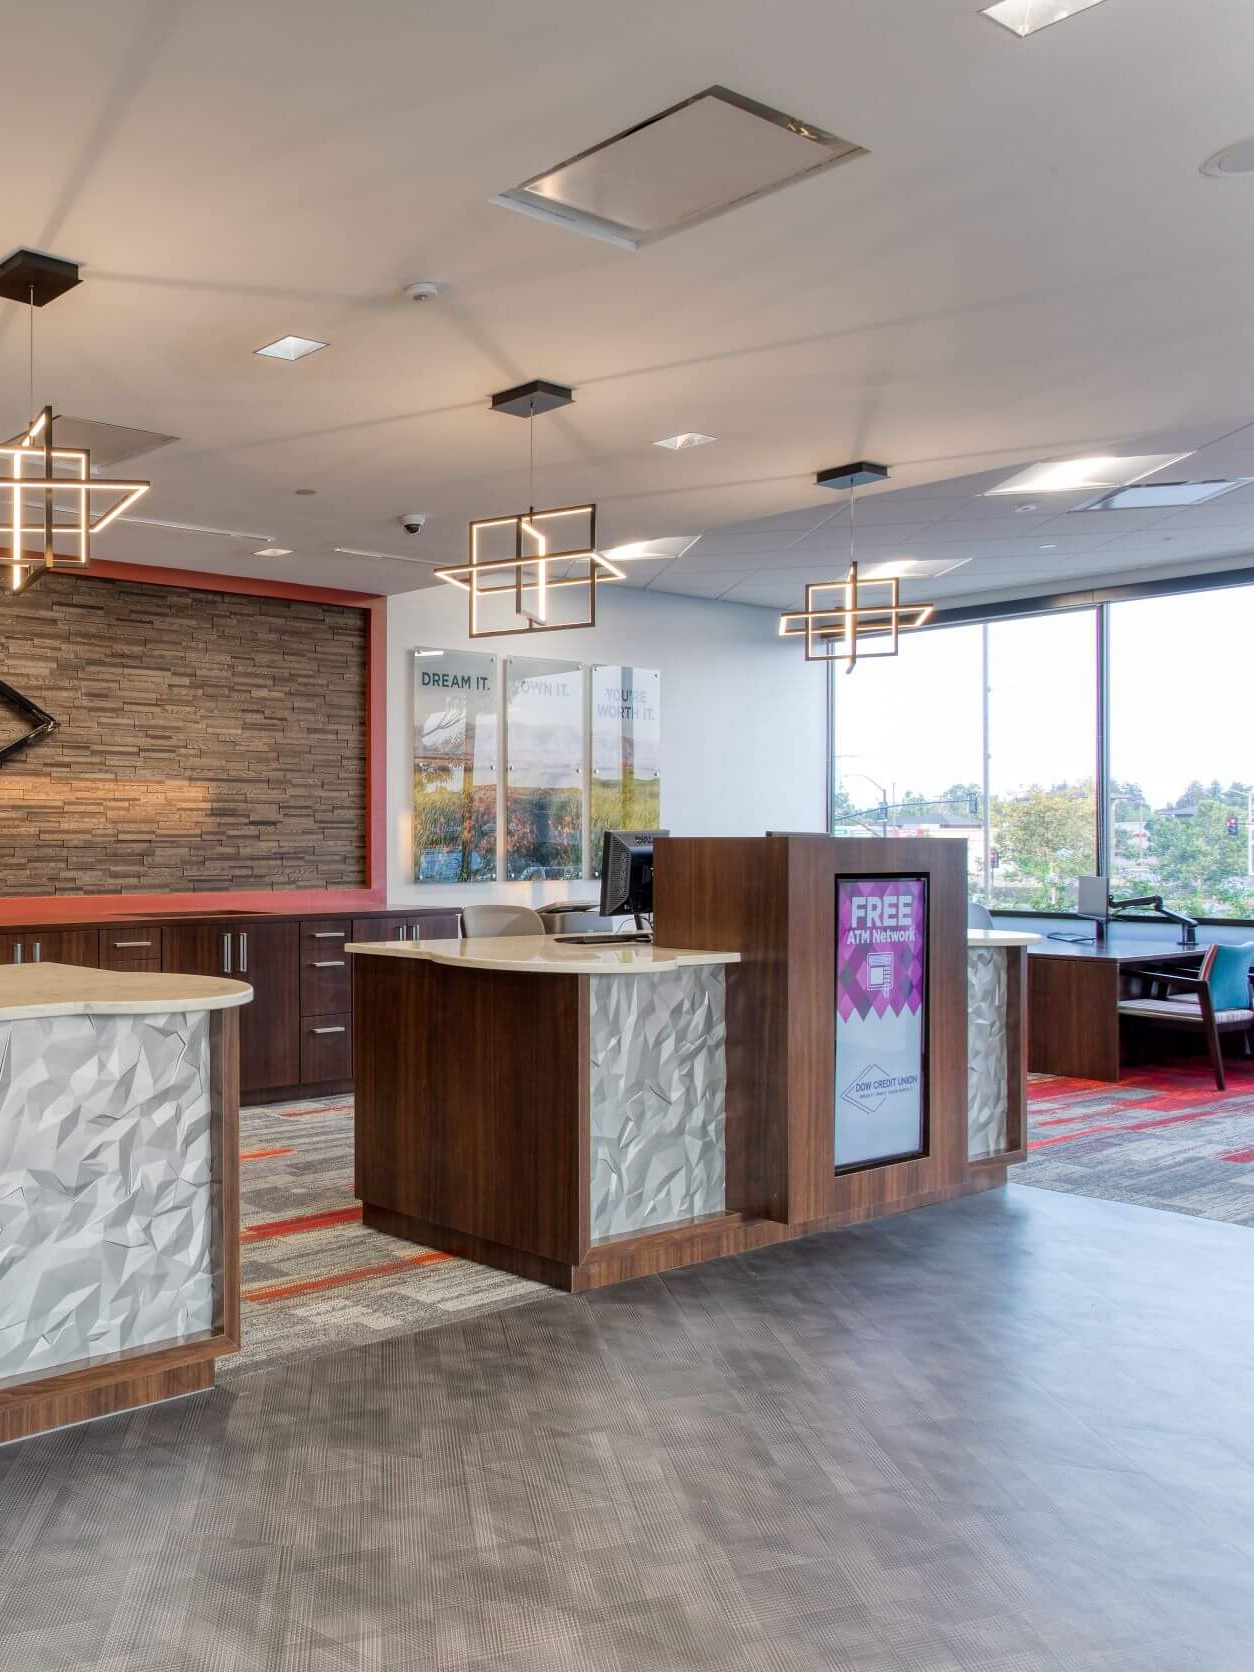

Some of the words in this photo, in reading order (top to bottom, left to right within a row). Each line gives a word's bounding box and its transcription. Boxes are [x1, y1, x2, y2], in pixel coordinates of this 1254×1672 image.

[421, 672, 471, 690] DREAM
[476, 677, 490, 691] IT.
[521, 680, 552, 696] OWN
[557, 683, 570, 696] IT.
[606, 688, 647, 703] YOU'RE
[597, 703, 639, 720] WORTH
[851, 895, 913, 928] FREE
[847, 929, 870, 945] ATM
[873, 927, 915, 943] Network
[856, 1082, 872, 1092] DOW
[873, 1078, 896, 1089] CREDIT
[898, 1075, 918, 1086] UNION
